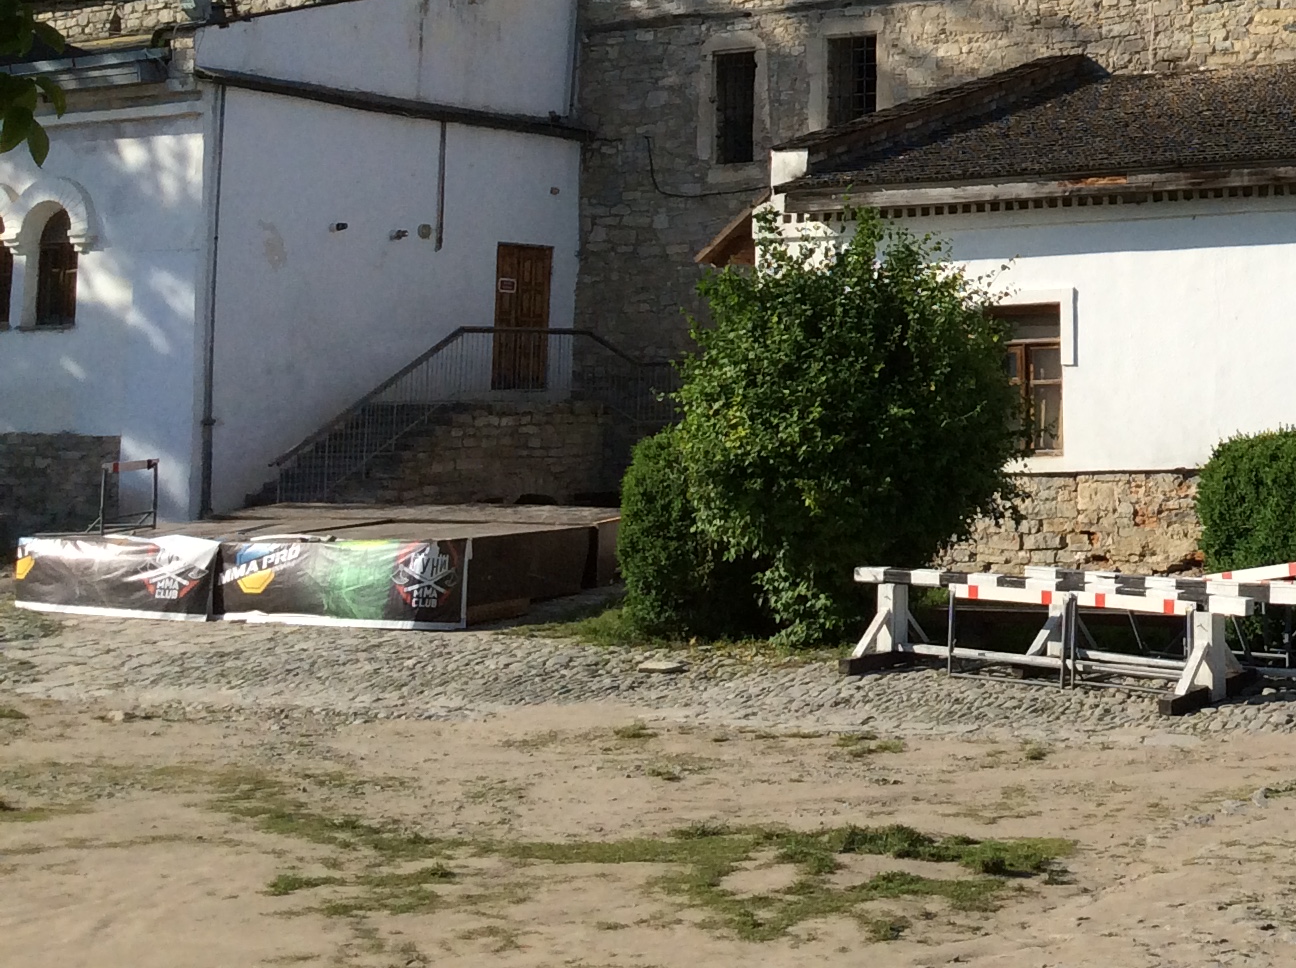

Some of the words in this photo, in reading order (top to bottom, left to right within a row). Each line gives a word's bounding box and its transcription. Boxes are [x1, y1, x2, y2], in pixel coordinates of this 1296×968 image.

[262, 543, 301, 569] PRO
[157, 578, 179, 589] MMA
[155, 589, 178, 599] CLUB
[413, 587, 438, 598] MMA
[412, 598, 438, 608] CLUB
